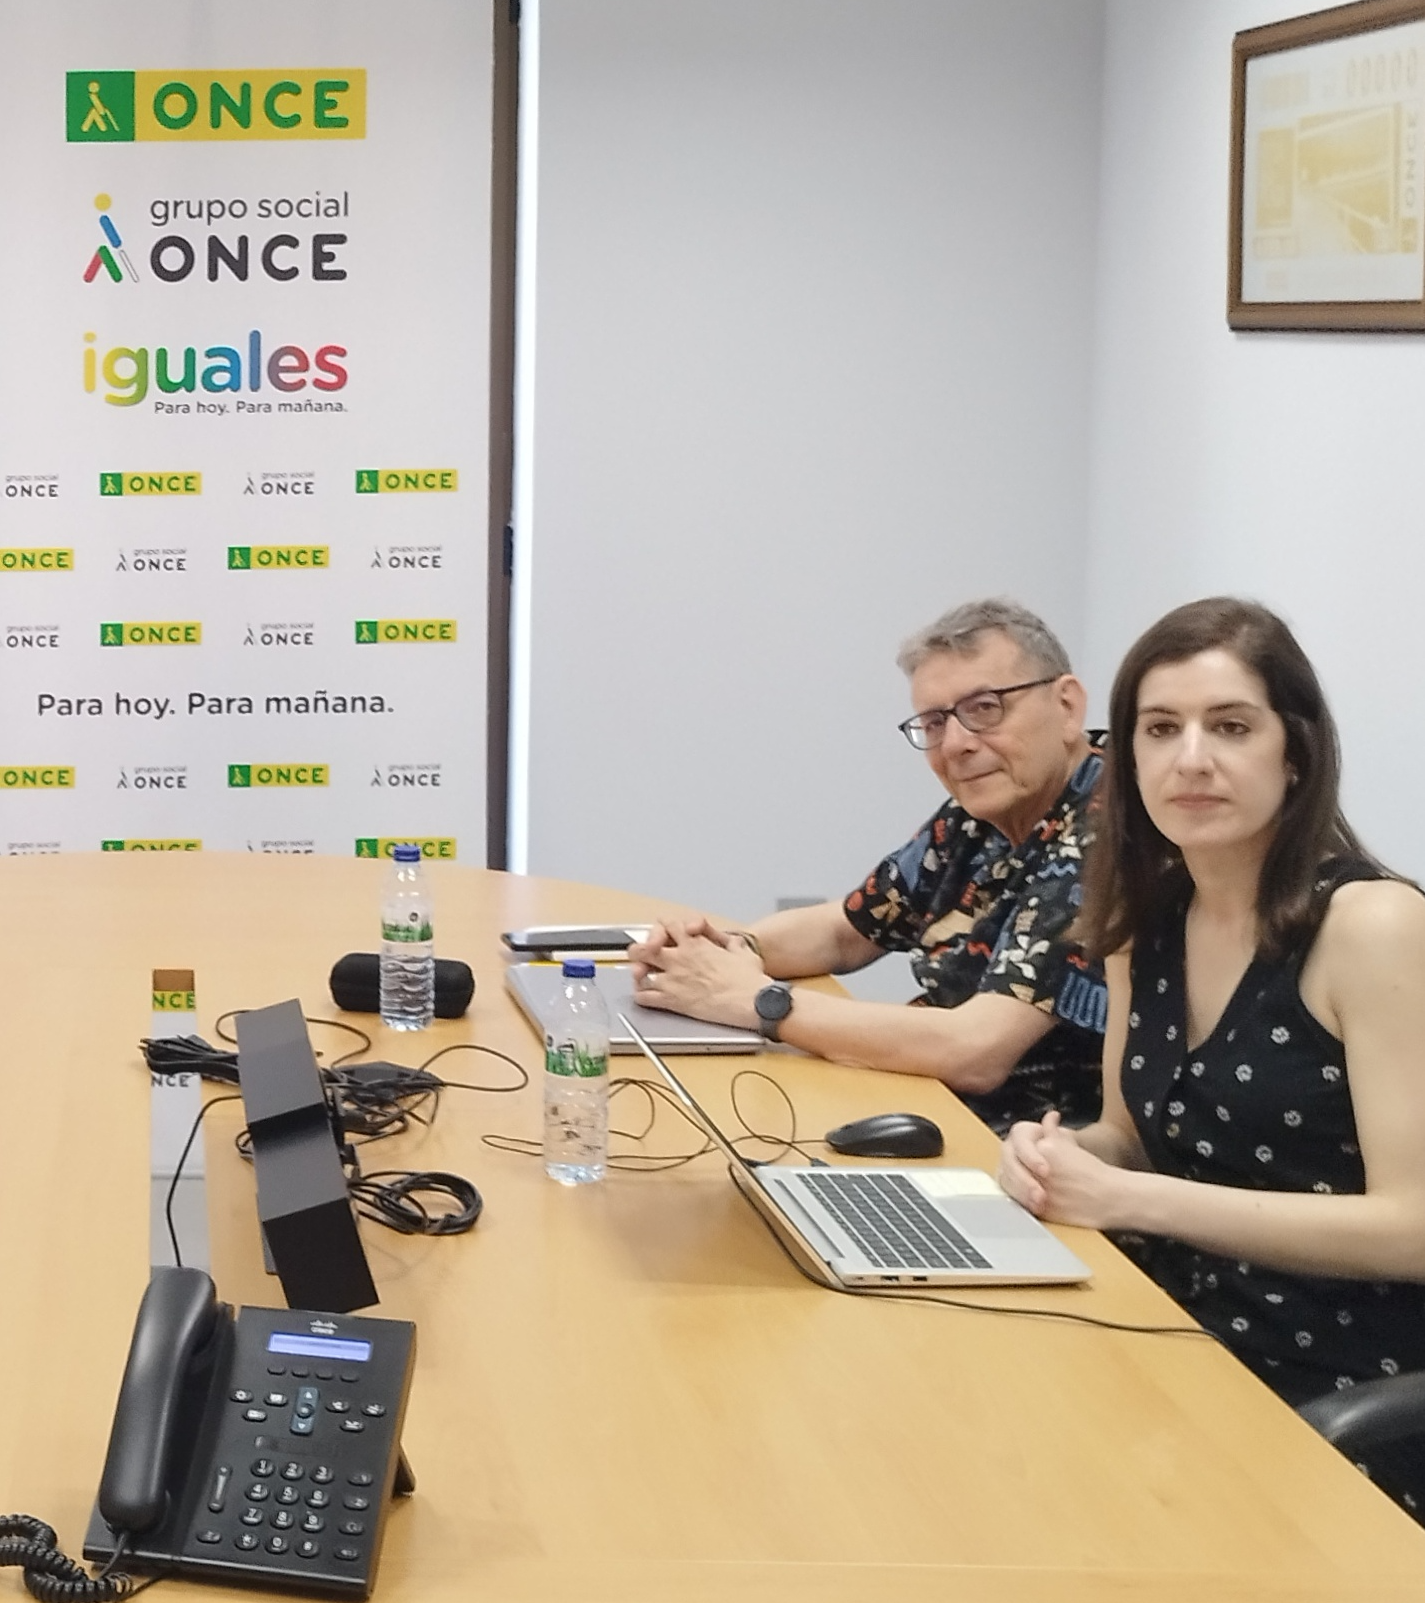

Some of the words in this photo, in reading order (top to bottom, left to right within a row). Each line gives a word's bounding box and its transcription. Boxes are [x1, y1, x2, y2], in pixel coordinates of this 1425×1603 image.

[153, 80, 350, 130] ONCE
[149, 197, 248, 226] grupo
[256, 191, 350, 220] social
[149, 233, 348, 283] ONCE
[83, 330, 348, 407] iguales
[154, 401, 191, 415] Para
[196, 400, 230, 416] hoy.
[236, 400, 272, 413] Para
[277, 398, 349, 413] mañana.
[129, 476, 197, 492] ONCE
[261, 482, 315, 495] ONCE
[385, 473, 453, 489] ONCE
[5, 484, 59, 498] ONCE
[2, 552, 70, 568] ONCE
[133, 558, 187, 571] ONCE
[257, 550, 325, 566] ONCE
[388, 555, 442, 569] ONCE
[129, 626, 197, 642] ONCE
[260, 632, 314, 646] ONCE
[384, 623, 452, 640] ONCE
[6, 635, 60, 648] ONCE
[37, 694, 103, 716] Para
[115, 692, 176, 720] hoy.
[188, 692, 254, 715] Para
[265, 690, 394, 714] mañana.
[3, 769, 70, 786] ONCE
[134, 775, 188, 789] ONCE
[257, 767, 324, 784] ONCE
[388, 773, 441, 787] ONCE
[384, 841, 452, 858] OCE
